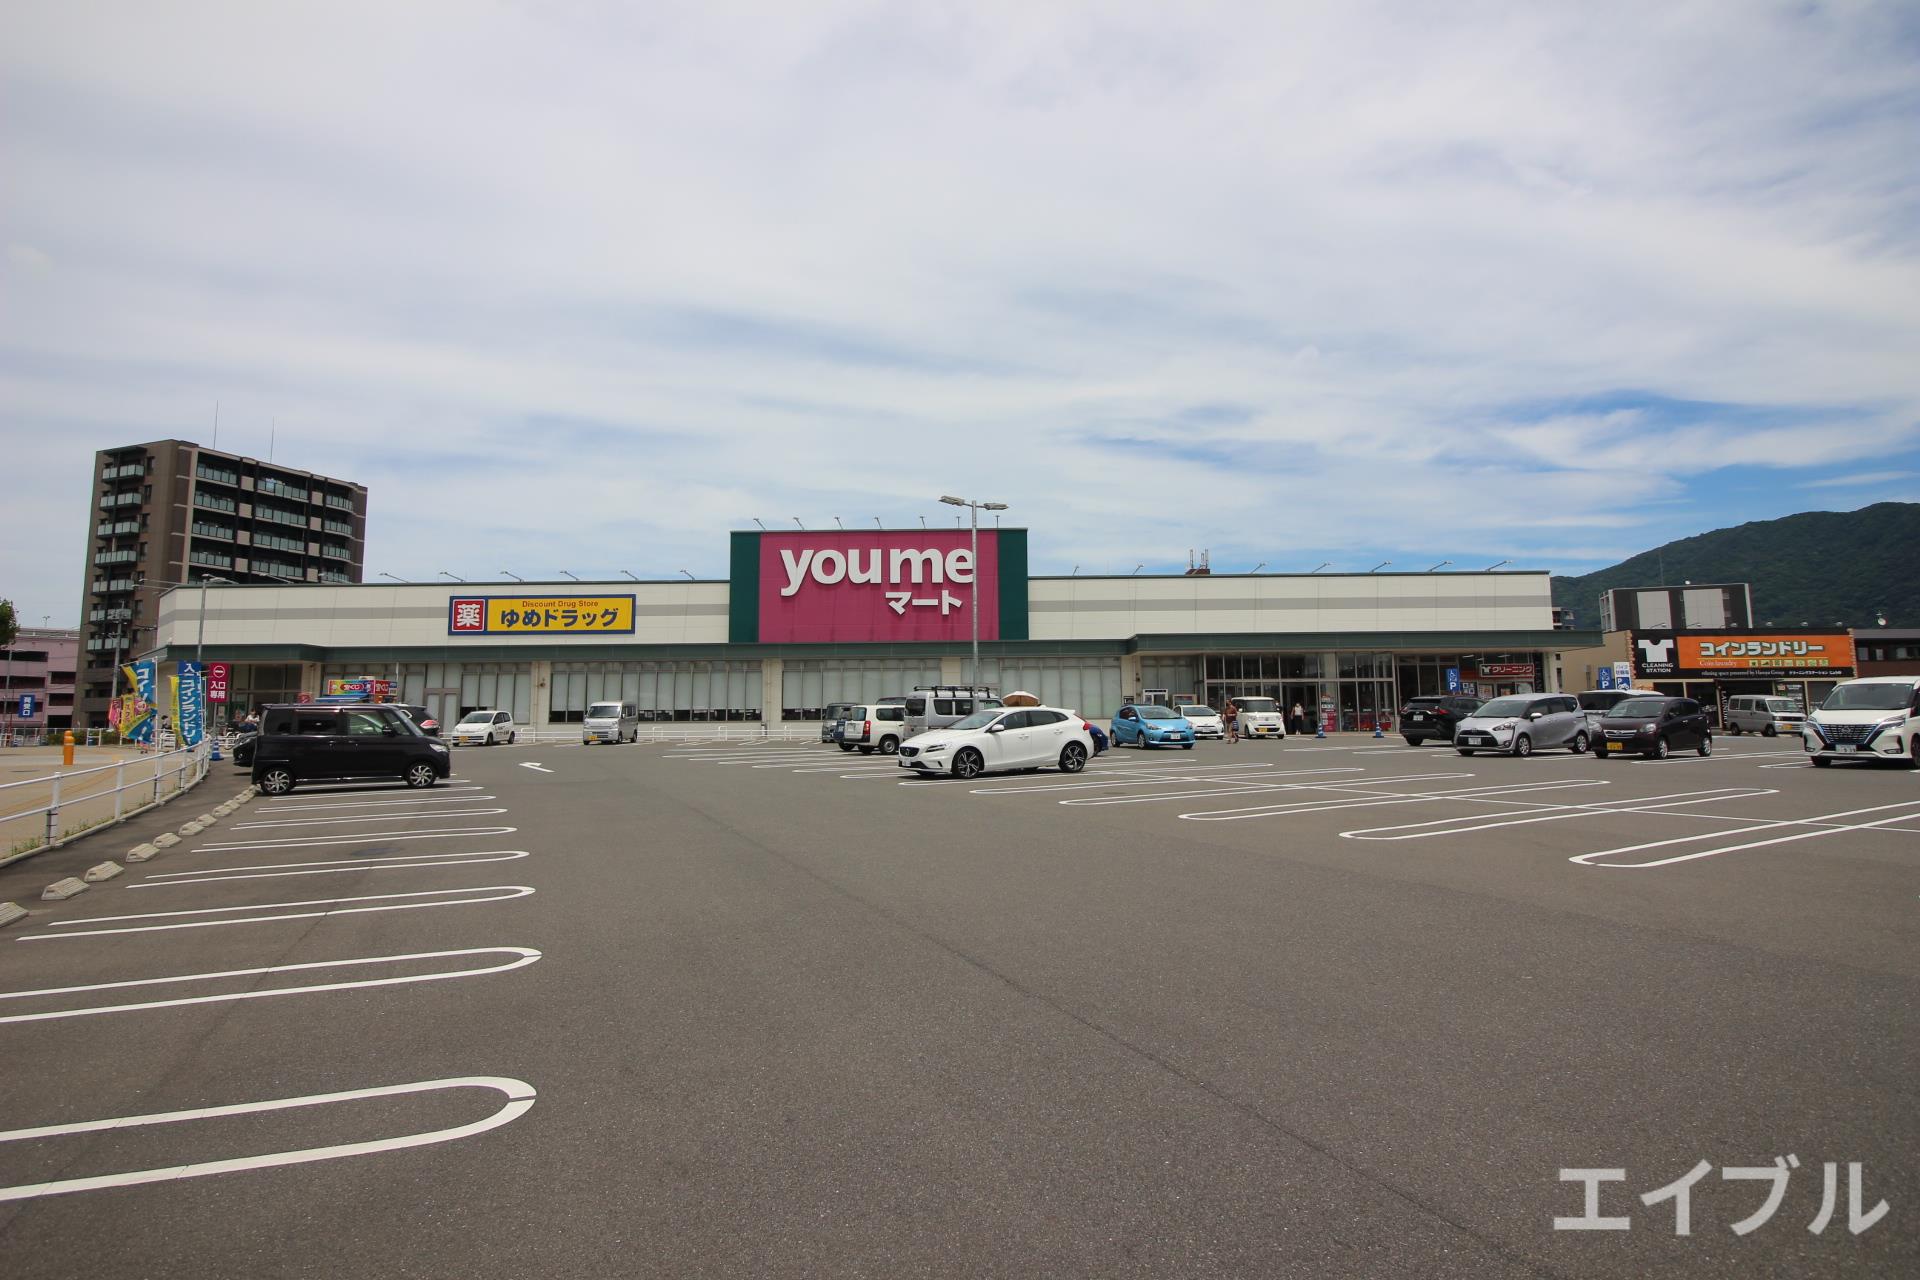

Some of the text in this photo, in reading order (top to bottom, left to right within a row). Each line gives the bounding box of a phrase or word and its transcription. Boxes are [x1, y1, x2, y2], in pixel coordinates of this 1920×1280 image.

[522, 599, 599, 609] Discount Drug Store
[886, 589, 962, 616] マート
[457, 603, 481, 628] 薬
[500, 608, 619, 628] ゆめドラッグ
[1699, 641, 1824, 657] コインランドリー
[1492, 665, 1533, 674] クリーニング
[210, 681, 226, 690] 入口
[1450, 682, 1457, 690] P
[1602, 681, 1609, 689] P
